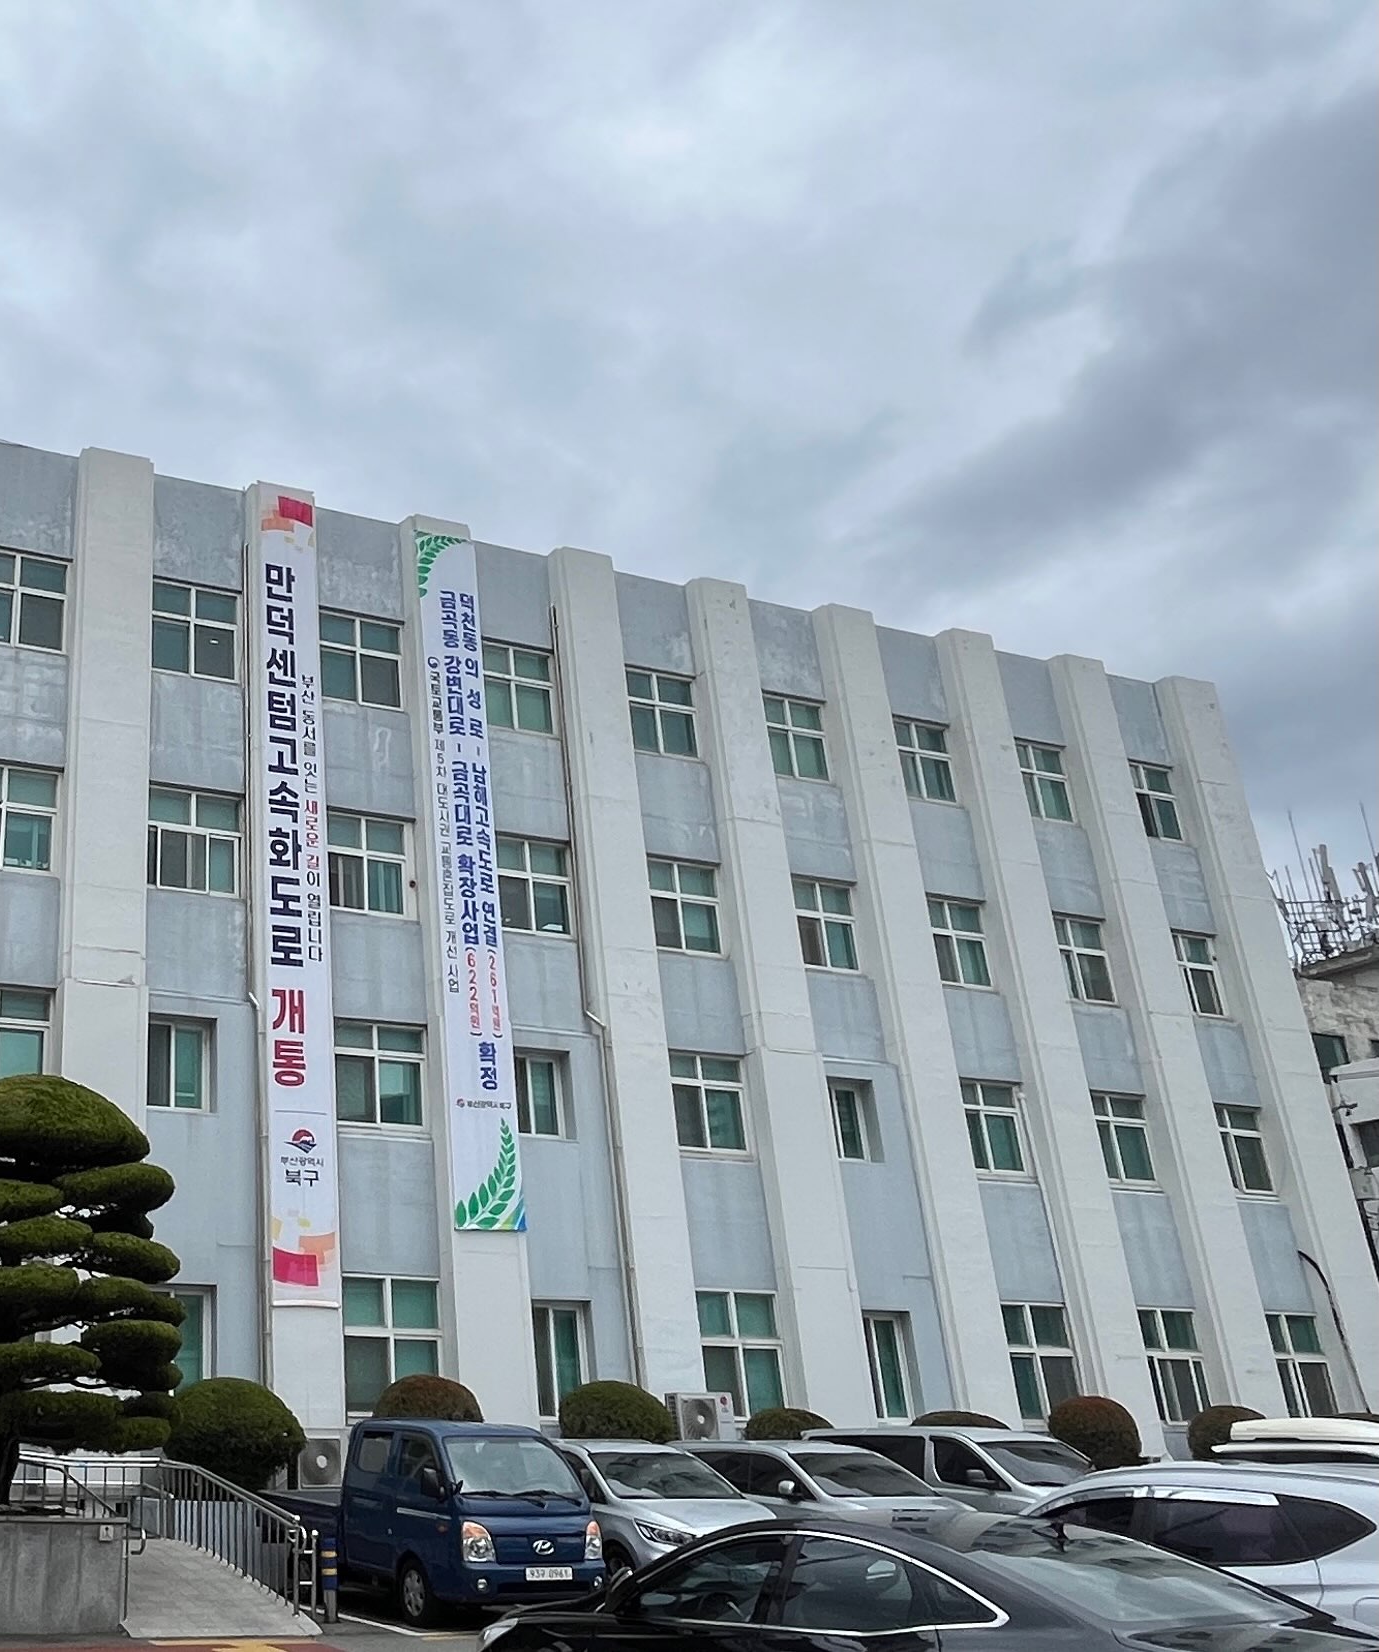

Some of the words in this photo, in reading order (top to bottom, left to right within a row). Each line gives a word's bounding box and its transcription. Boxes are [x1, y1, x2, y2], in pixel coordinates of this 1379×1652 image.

[440, 590, 459, 649] 금곡동
[460, 592, 477, 652] 덕천동
[301, 674, 314, 705] 부산
[444, 655, 466, 736] 강변대로
[302, 709, 316, 757] 동서를
[265, 563, 304, 967] 만덕센텀고속화도로
[303, 762, 317, 794] 잇는
[304, 799, 319, 848] 새로운
[452, 761, 473, 846] 금곡대로
[306, 854, 320, 887] 길이
[307, 893, 323, 962] 열립니다
[446, 930, 458, 959] 개선
[272, 988, 306, 1087] 개통
[479, 1042, 497, 1090] 확정
[281, 1156, 324, 1167] 부산광역시
[285, 1169, 319, 1187] 북구
